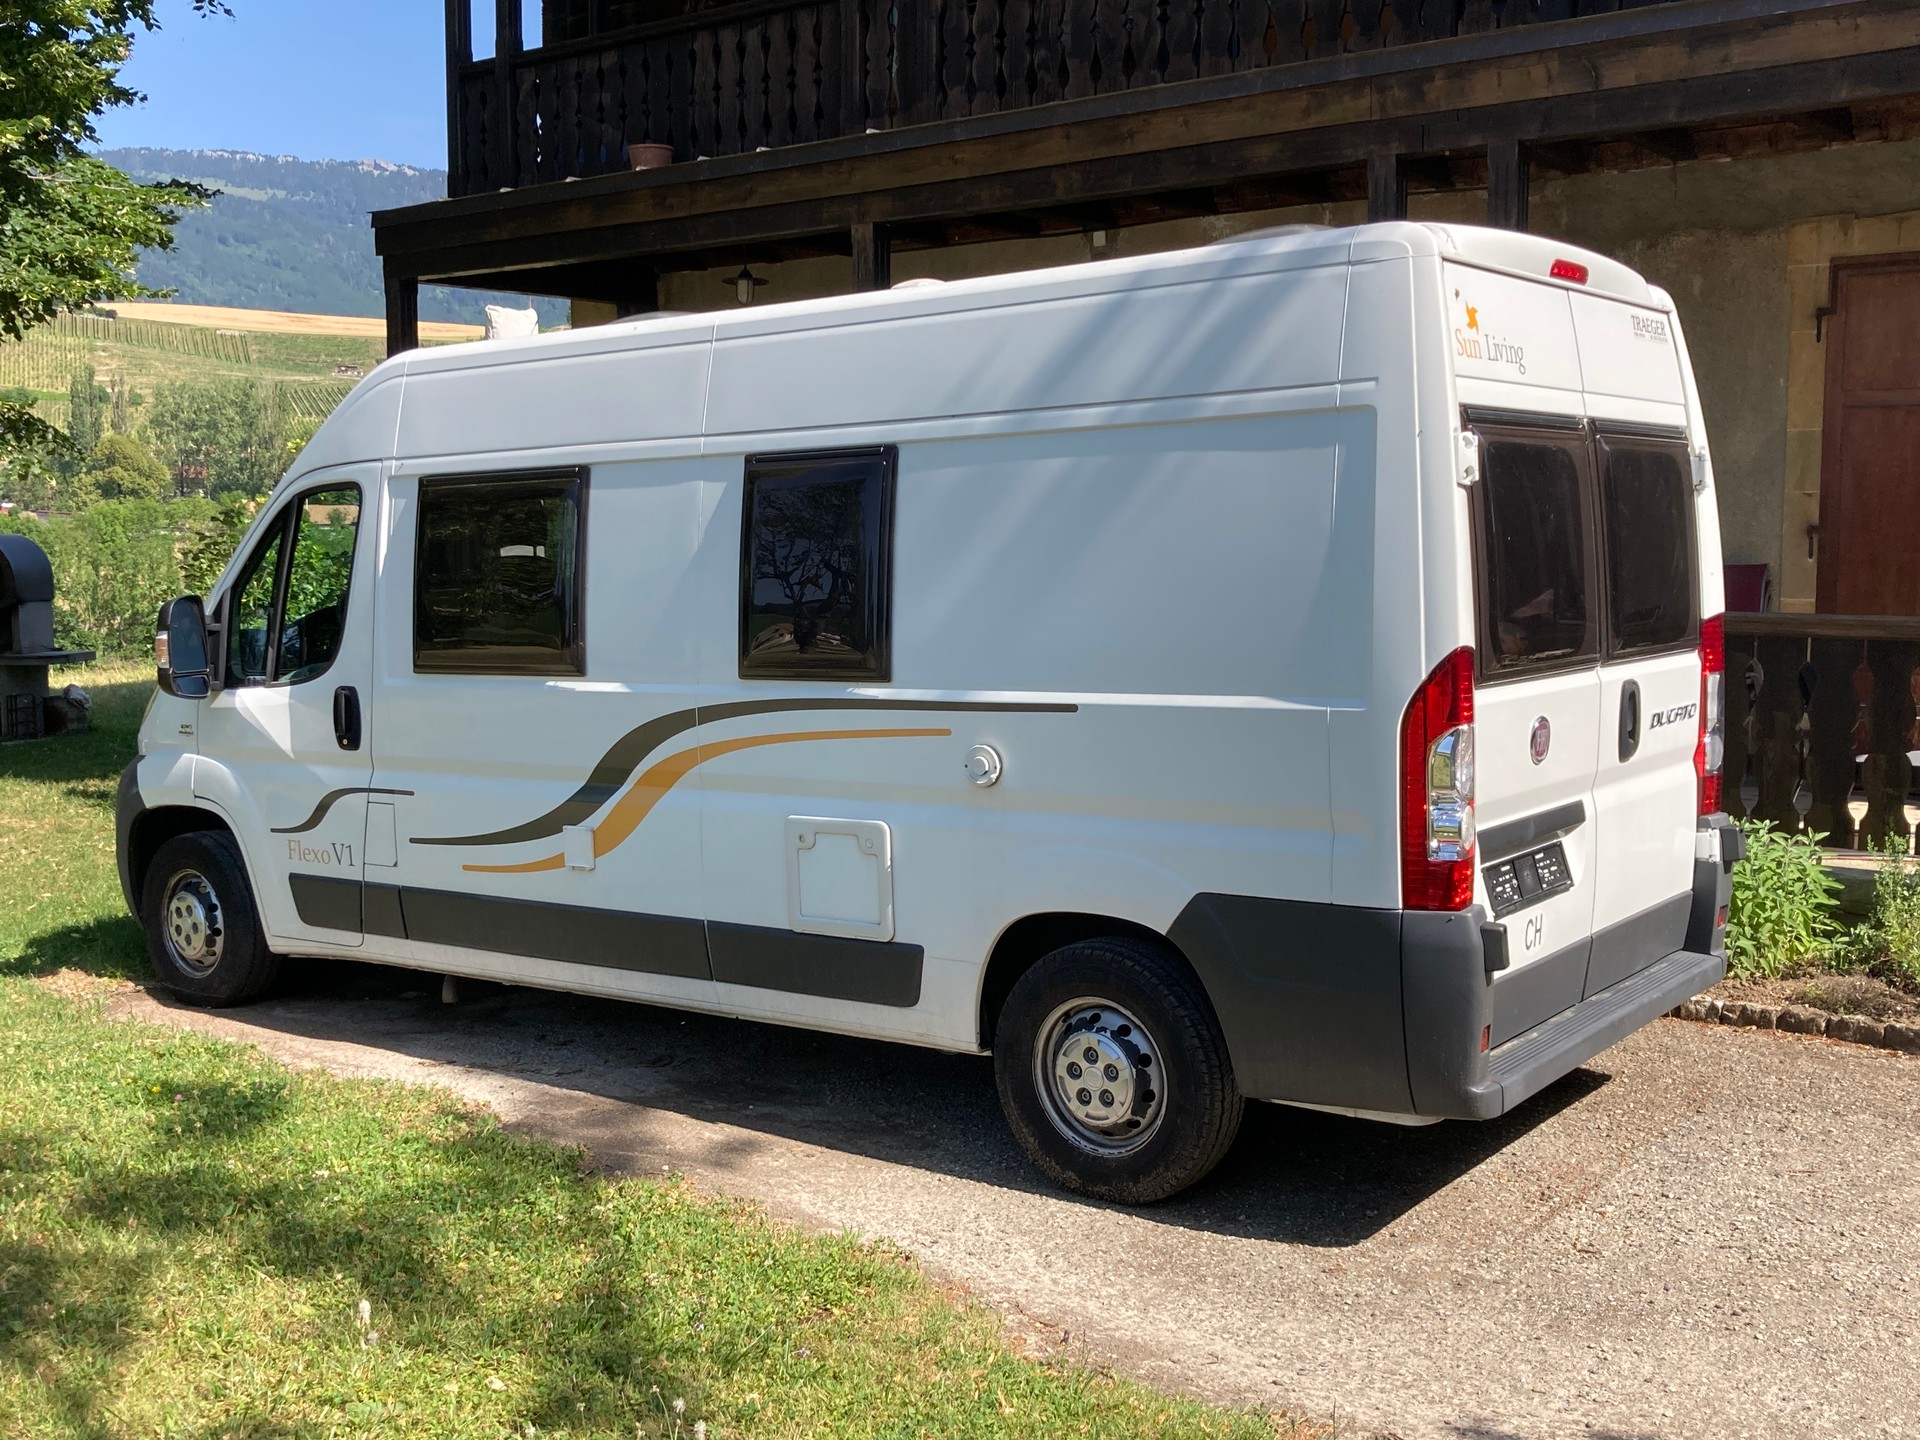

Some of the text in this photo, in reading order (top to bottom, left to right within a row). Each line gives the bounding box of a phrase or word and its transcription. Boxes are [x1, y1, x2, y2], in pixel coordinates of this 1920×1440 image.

[1631, 315, 1667, 337] TRAEGER
[1455, 328, 1526, 375] Sun Living
[1649, 703, 1697, 730] DUCATO
[287, 839, 356, 867] Flexo V1
[1525, 913, 1543, 950] CH
